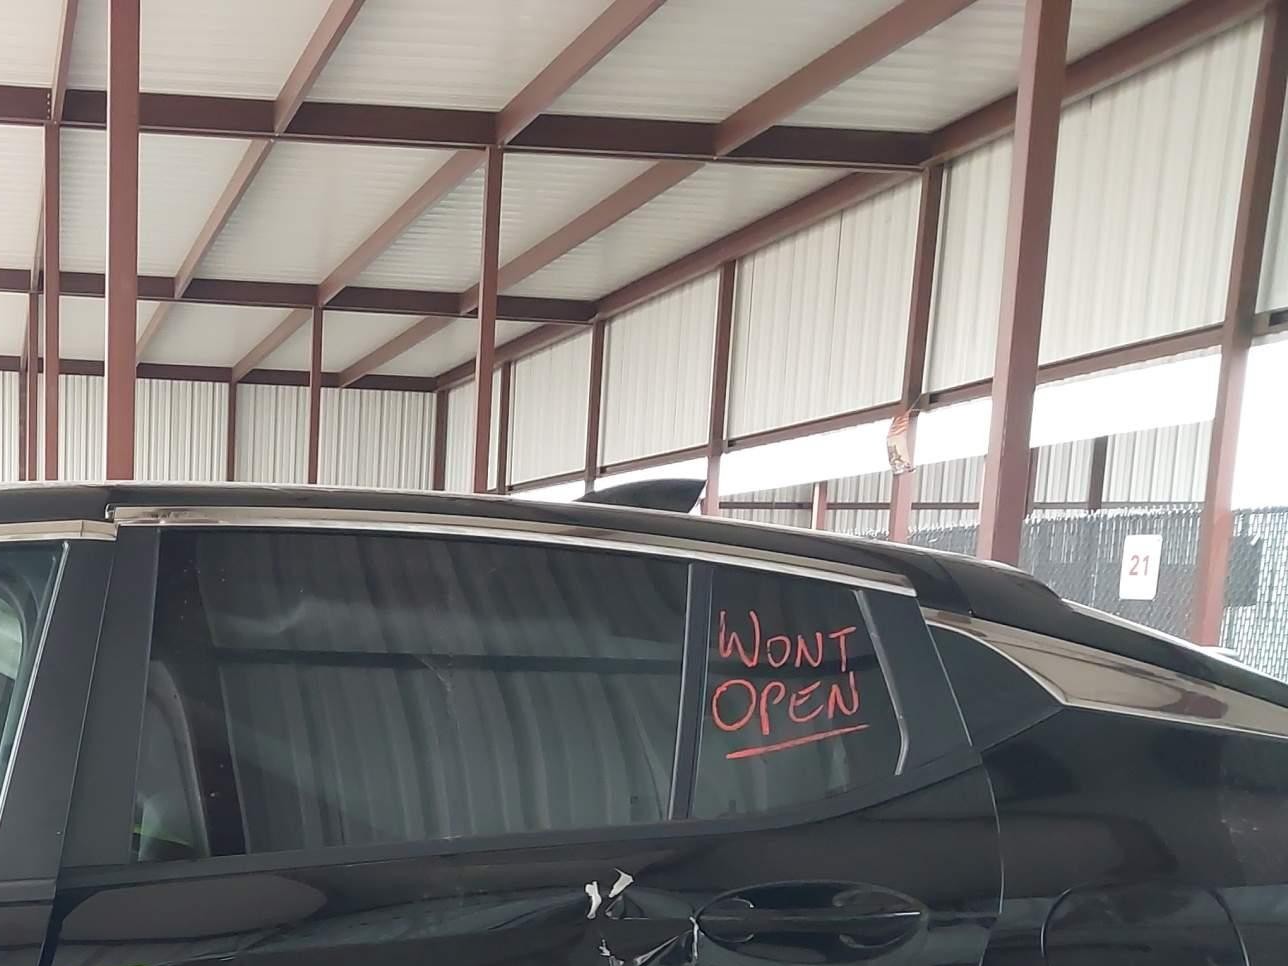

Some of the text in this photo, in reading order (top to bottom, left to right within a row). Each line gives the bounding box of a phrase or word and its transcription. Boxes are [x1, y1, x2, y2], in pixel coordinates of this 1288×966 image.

[1128, 554, 1150, 576] 21
[718, 610, 857, 673] WONT
[712, 671, 861, 736] OPEN
